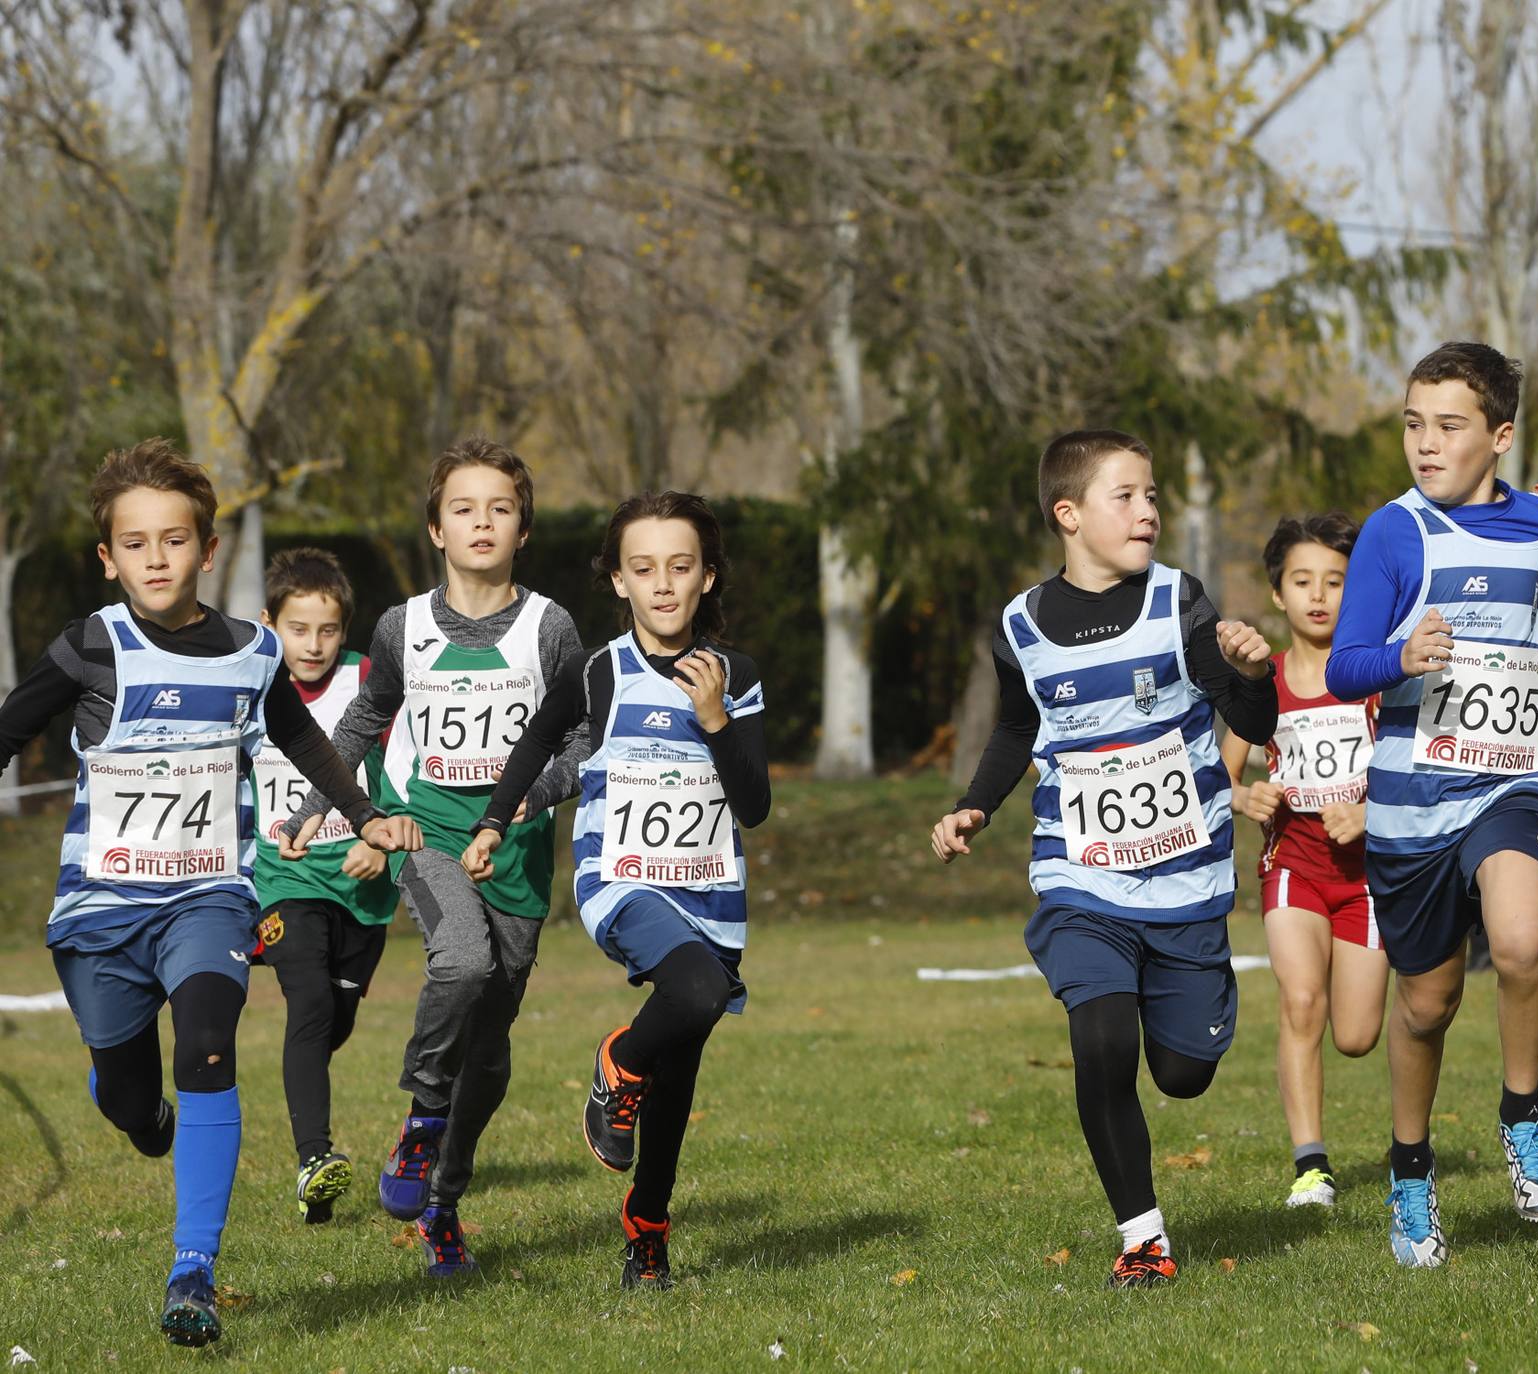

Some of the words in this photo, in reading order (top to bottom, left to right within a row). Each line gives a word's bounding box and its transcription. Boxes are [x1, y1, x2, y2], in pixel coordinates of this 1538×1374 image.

[1075, 624, 1121, 640] KIPSTA
[1432, 654, 1481, 666] ierno
[1507, 658, 1517, 670] de
[1519, 659, 1527, 671] La
[409, 680, 449, 692] Gobierno
[474, 682, 487, 692] de
[490, 682, 503, 690] La
[506, 677, 531, 690] Rioja
[417, 702, 529, 751] 1513
[1313, 719, 1323, 728] de
[1326, 717, 1338, 727] La
[1340, 715, 1363, 725] Rioja
[1462, 739, 1500, 752] FEDERACIÓN
[1529, 746, 1535, 754] DE
[255, 757, 291, 767] Gobierno
[447, 756, 488, 765] FEDERACIÓN
[489, 755, 508, 764] RIOJA
[1061, 763, 1100, 776] Gobierno
[1126, 759, 1140, 770] de
[1142, 755, 1157, 766] La
[1158, 742, 1183, 761] Rioja
[1459, 748, 1534, 771] ATLETISMO
[90, 763, 144, 777] Gobierno
[173, 765, 187, 776] de
[190, 764, 204, 775] La
[207, 761, 233, 775] Rioja
[448, 763, 504, 781] ATLETS
[609, 773, 657, 786] Gobierno
[683, 774, 696, 785] de
[699, 774, 710, 784] La
[264, 777, 306, 814] 15
[1068, 769, 1189, 835] 1633
[114, 789, 212, 841] 774
[614, 797, 728, 848] 1627
[315, 823, 352, 839] ETISM
[1112, 835, 1154, 850] FEDERACIÓN
[1155, 826, 1183, 841] RIOJANA
[1184, 822, 1193, 832] DE
[135, 848, 182, 861] FEDERACIÓN
[183, 848, 213, 858] RIOJANA
[215, 847, 225, 856] DE
[1115, 828, 1197, 867] ATLETISMO
[135, 857, 225, 876] ATLETISMO
[647, 856, 689, 866] FEDERACIÓN
[691, 854, 714, 864] RIOJANA
[716, 853, 724, 862] DE
[647, 861, 725, 881] ATLETISMO
